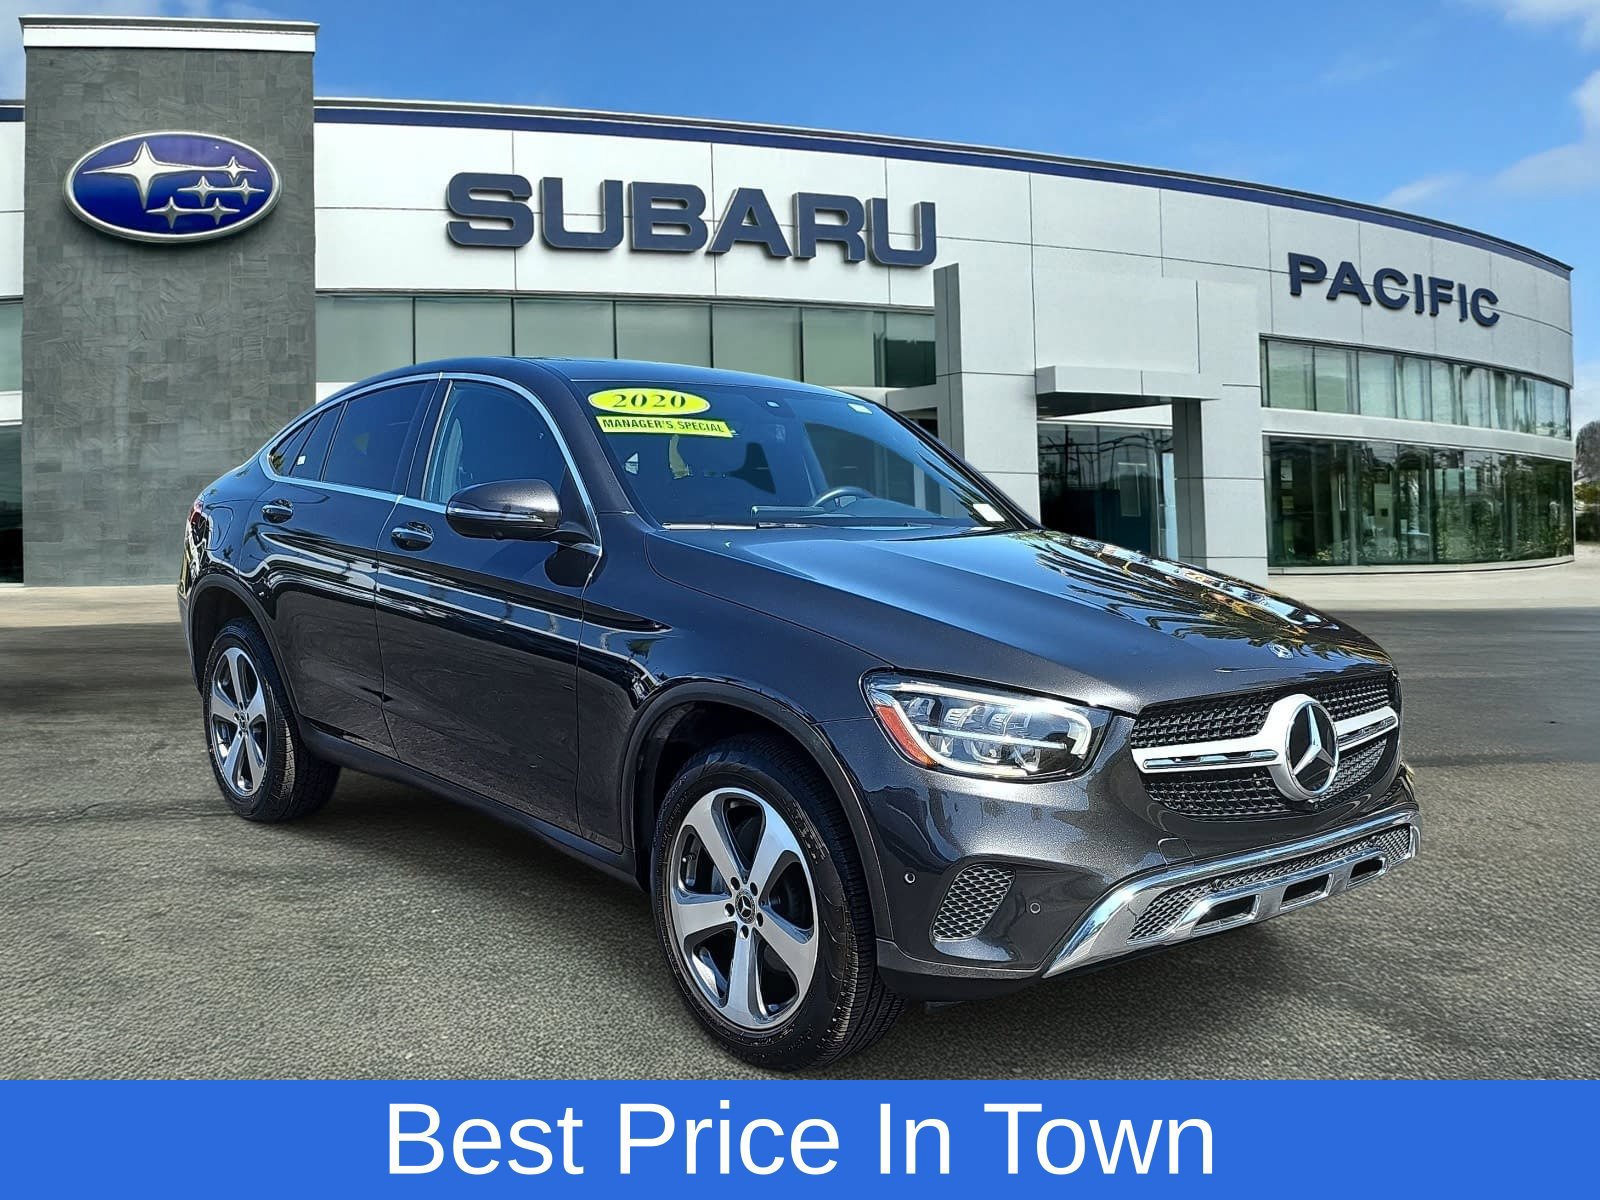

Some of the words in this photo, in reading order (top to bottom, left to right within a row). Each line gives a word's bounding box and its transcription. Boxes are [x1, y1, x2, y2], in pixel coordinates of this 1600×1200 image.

[447, 172, 937, 267] SUBARU
[1287, 252, 1500, 328] PACIFIC
[612, 393, 687, 408] 2020
[602, 418, 673, 429] MANAGER'S
[678, 420, 725, 433] SPECIAL
